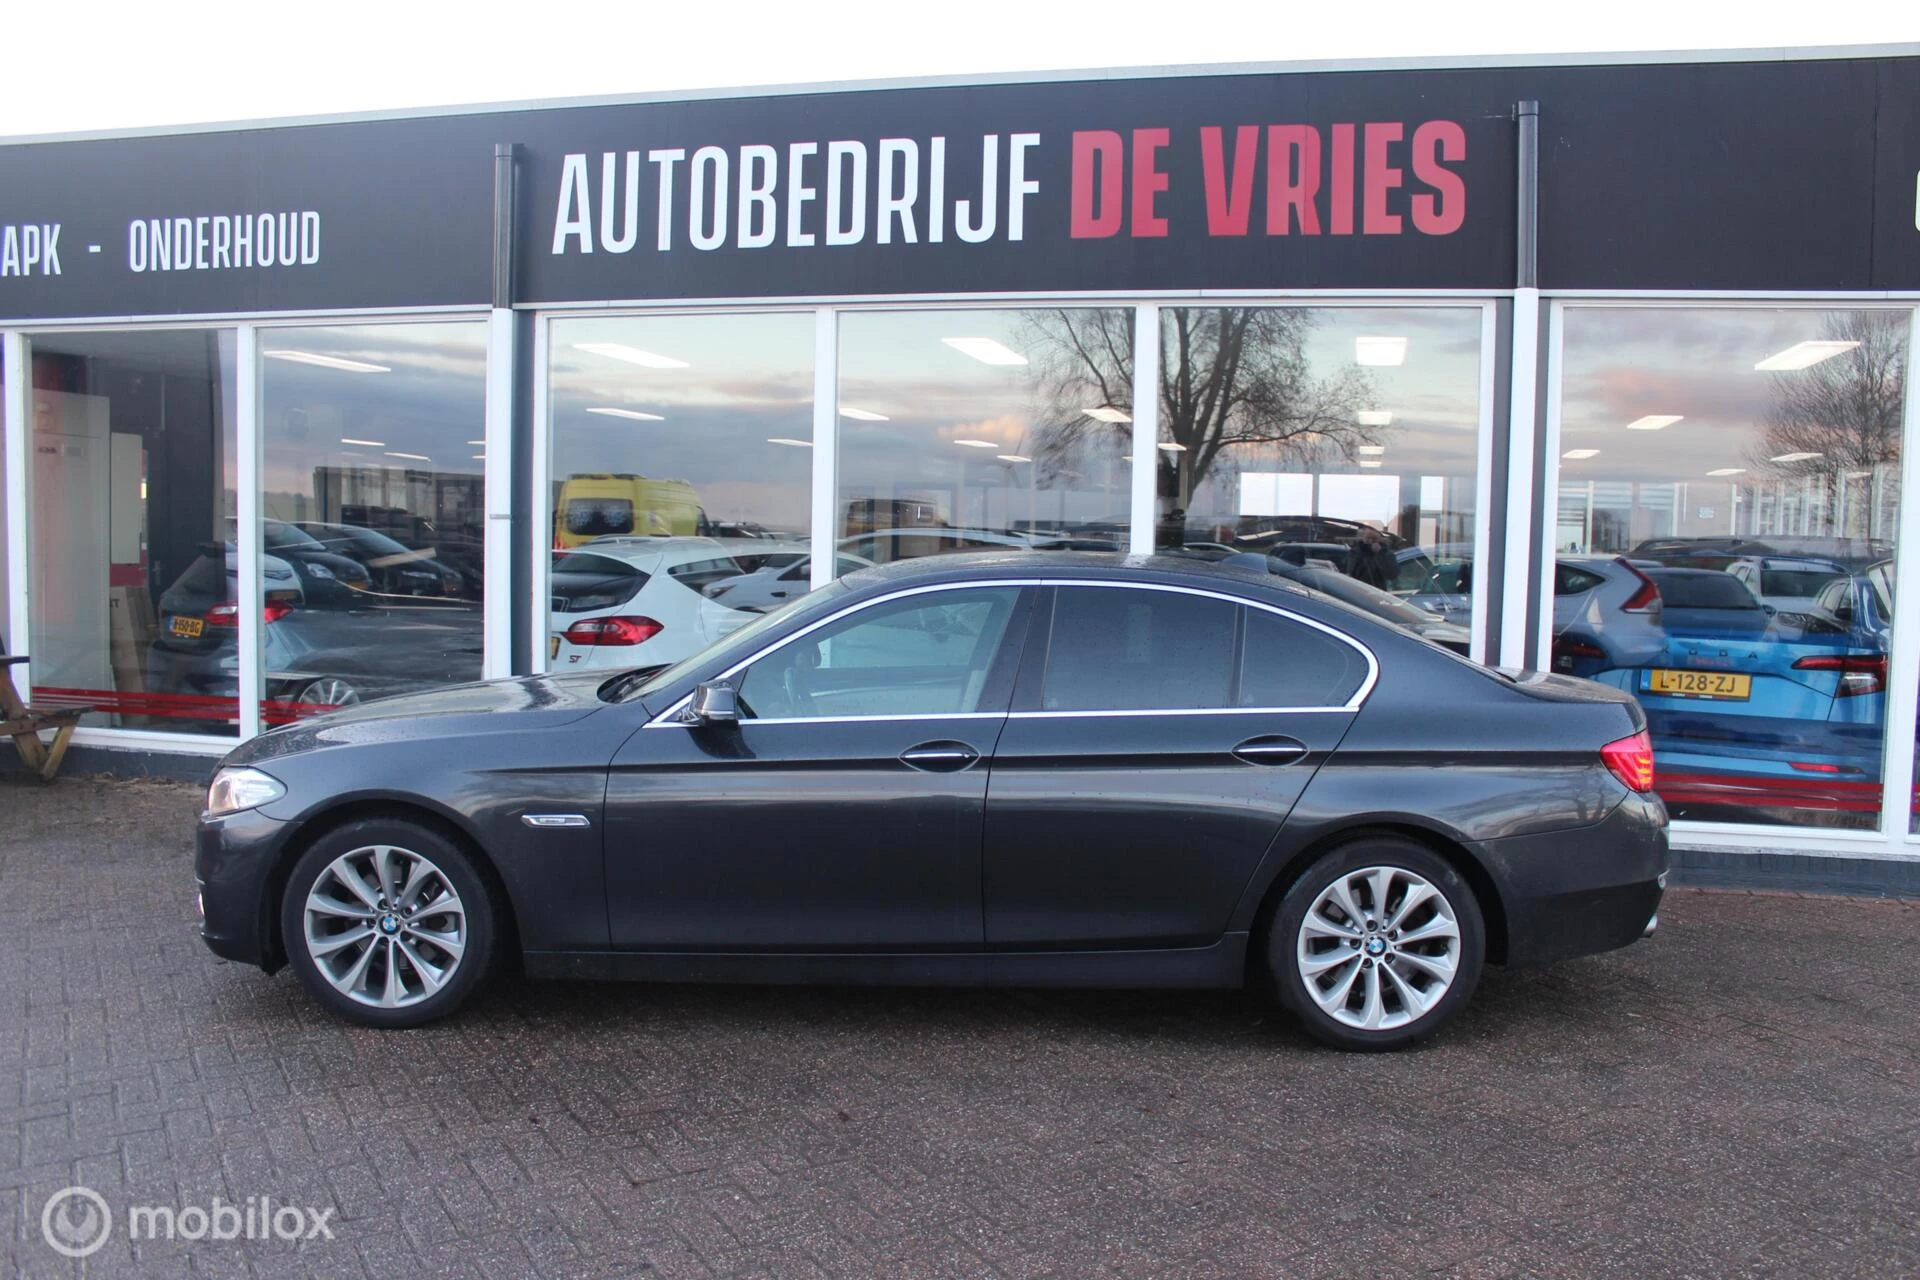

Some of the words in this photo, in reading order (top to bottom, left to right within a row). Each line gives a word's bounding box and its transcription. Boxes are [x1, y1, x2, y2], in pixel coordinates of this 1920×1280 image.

[552, 132, 1041, 255] AUTOBEDRIJF
[1070, 127, 1170, 239] DE
[1200, 119, 1466, 237] VRIES
[2, 223, 62, 277] APK
[129, 210, 320, 273] ONDERHOUD
[568, 655, 582, 664] ST
[1659, 673, 1735, 693] L-128-ZJ
